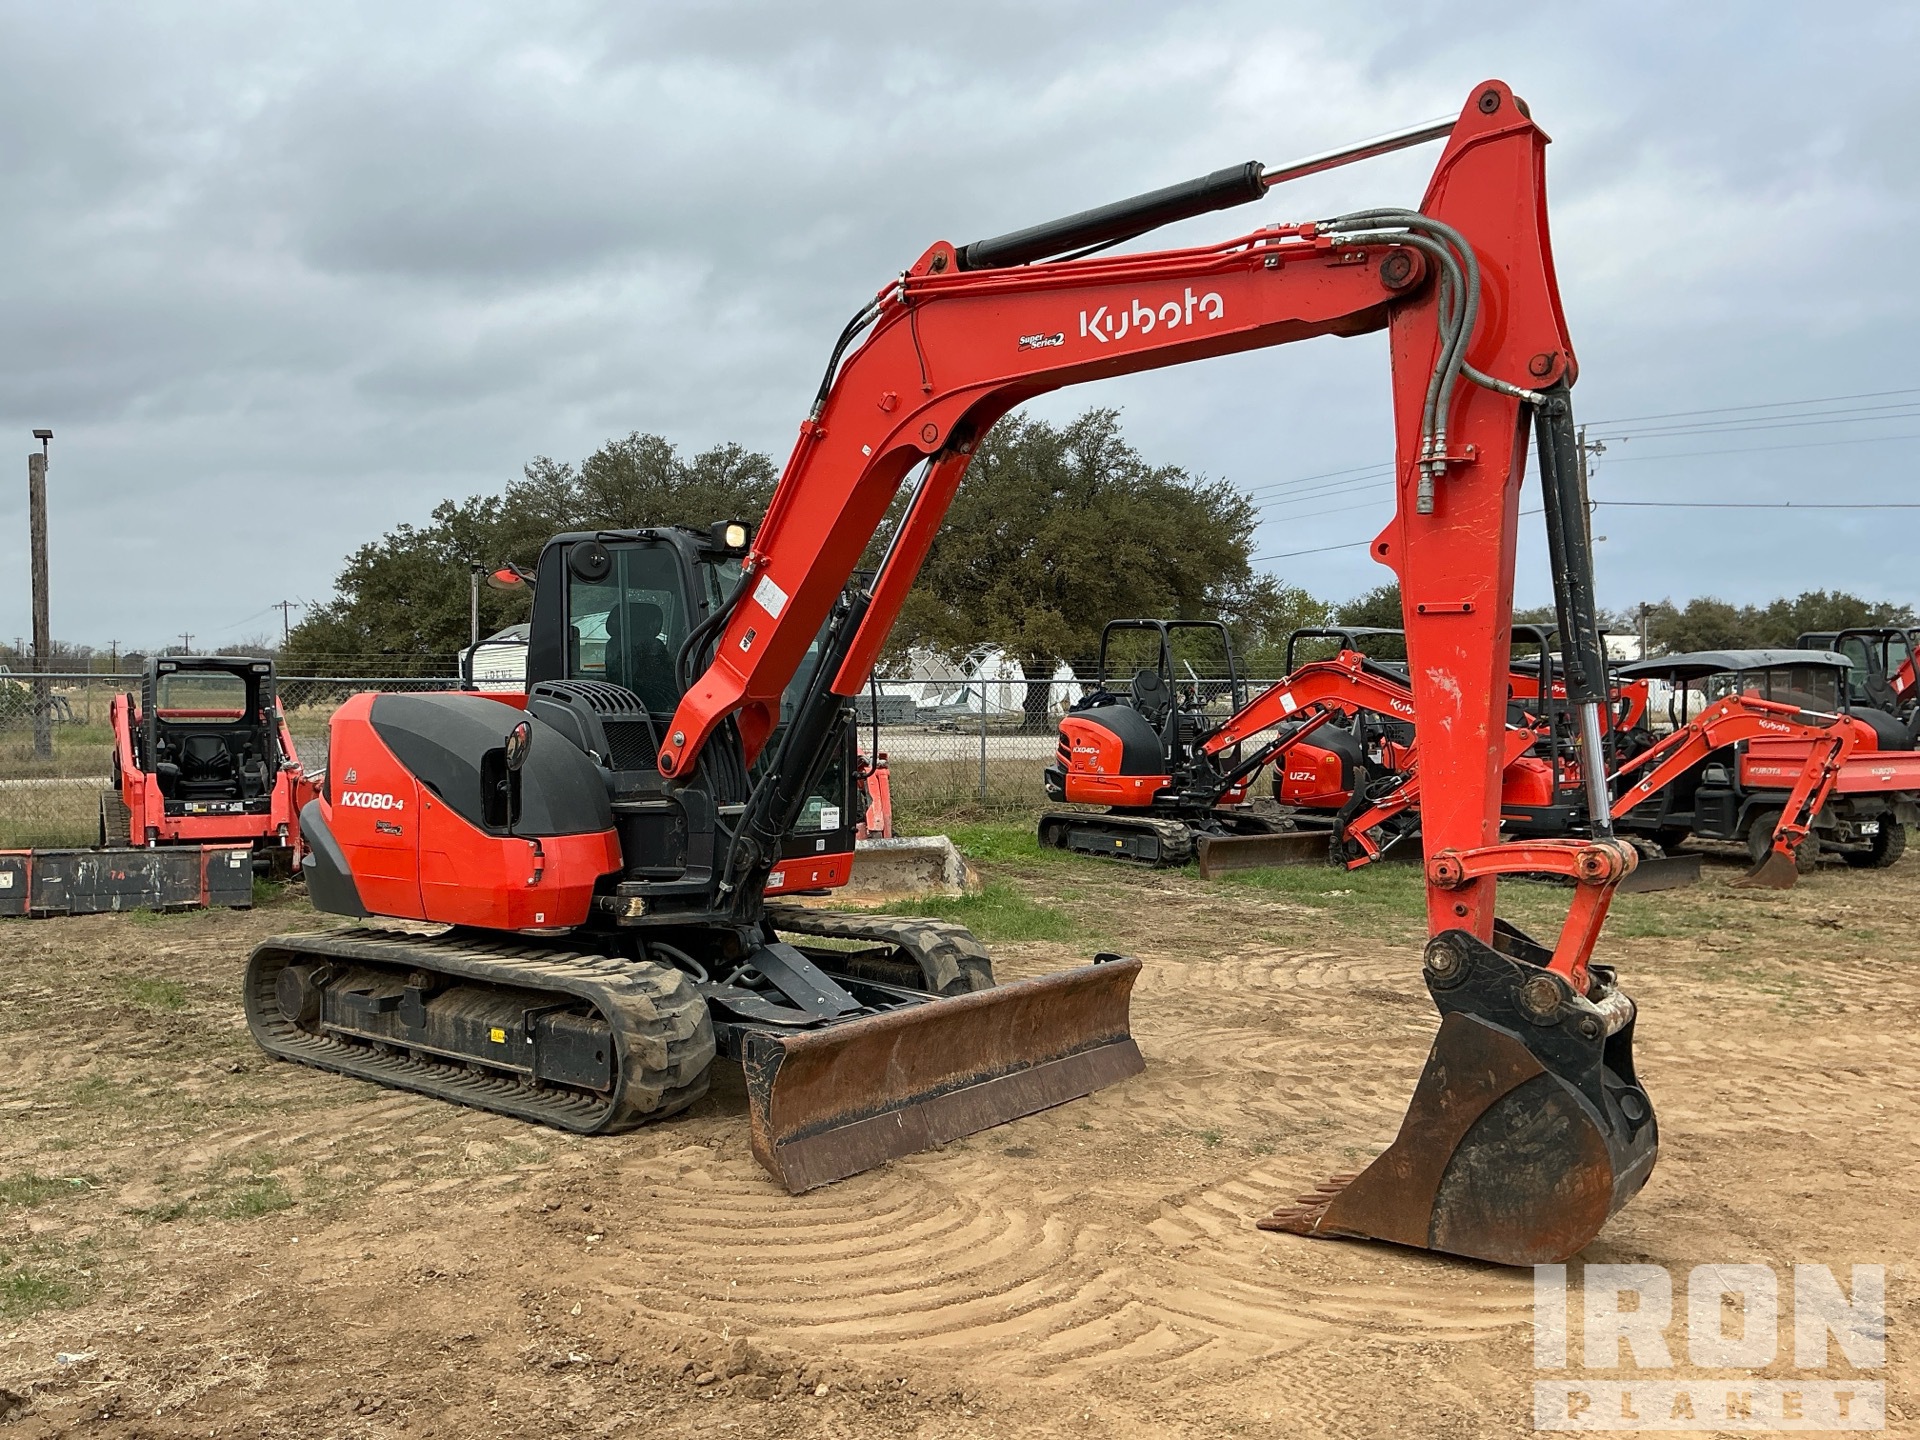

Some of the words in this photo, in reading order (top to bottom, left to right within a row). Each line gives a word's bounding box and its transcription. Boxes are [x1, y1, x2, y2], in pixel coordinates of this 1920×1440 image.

[1079, 287, 1224, 343] Kubota
[1389, 698, 1415, 715] Kub
[1758, 719, 1791, 733] Kubota
[1289, 771, 1316, 781] U27-4
[341, 791, 404, 811] KX080-4
